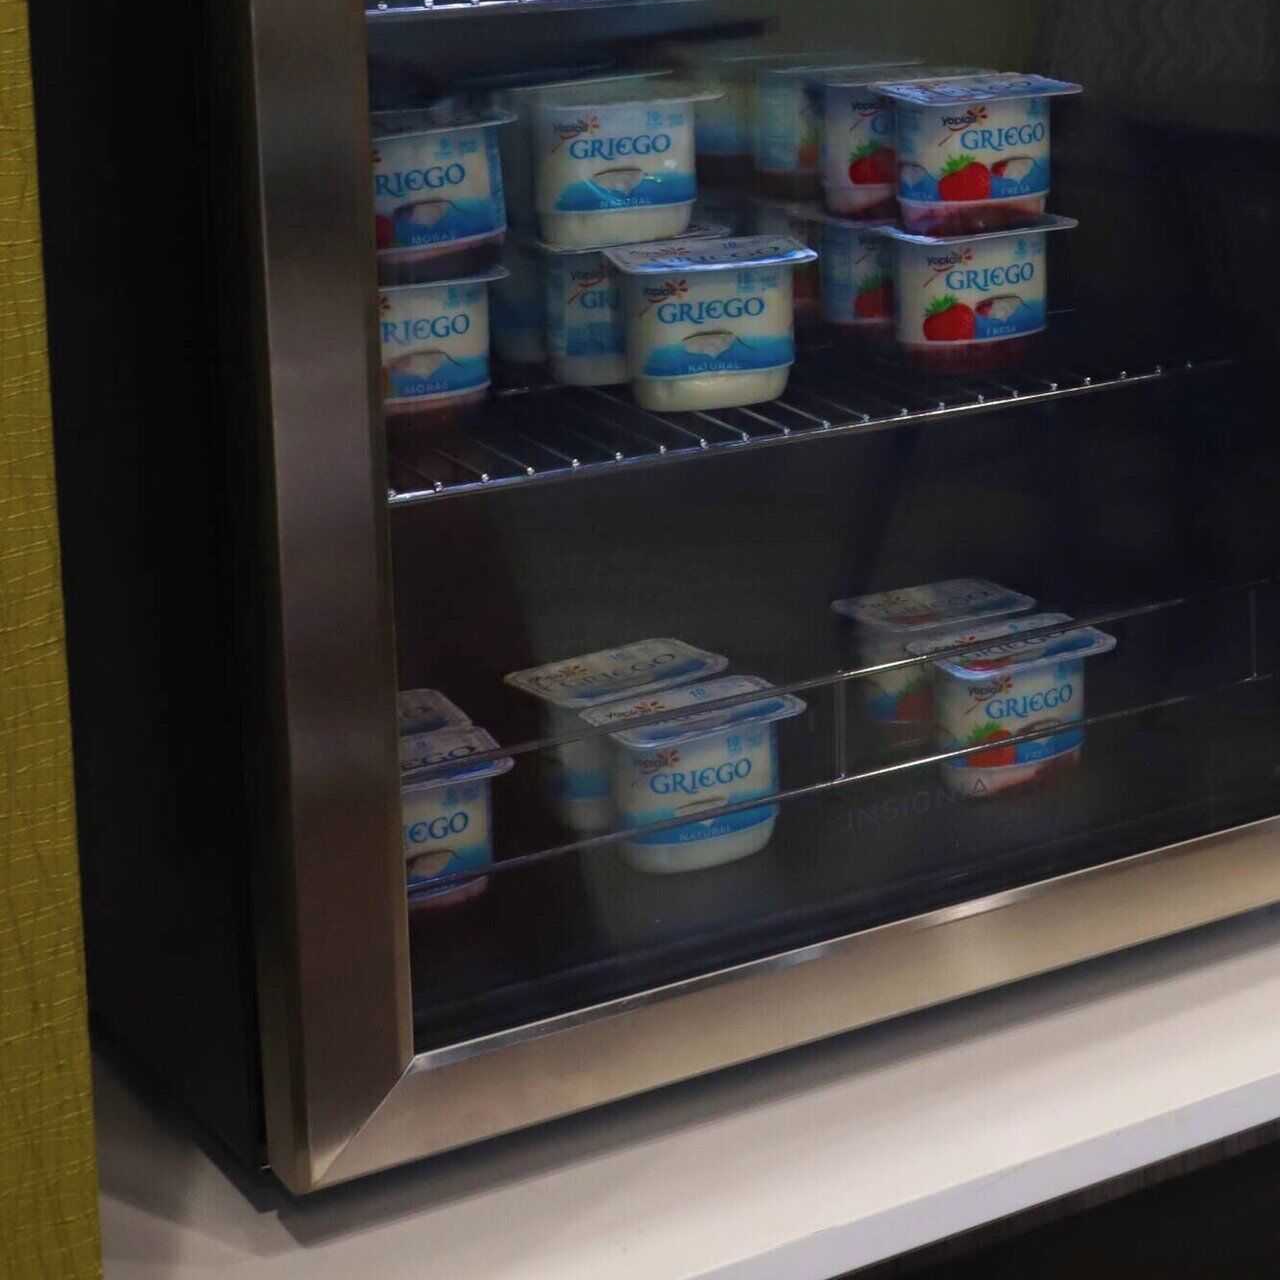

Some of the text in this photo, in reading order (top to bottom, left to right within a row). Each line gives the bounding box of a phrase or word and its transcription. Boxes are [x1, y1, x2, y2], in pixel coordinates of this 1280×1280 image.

[570, 134, 671, 161] GRIEGO
[960, 122, 1045, 151] GRIEGO
[375, 163, 465, 197] RIEGO
[945, 261, 1034, 292] GRIEGO
[657, 297, 765, 324] GRIEGO
[382, 314, 470, 346] RIEGO
[688, 362, 741, 373] NATURAL
[404, 380, 449, 396] MORAS
[985, 684, 1073, 720] GRIEGO
[651, 757, 752, 794] GRIEGO
